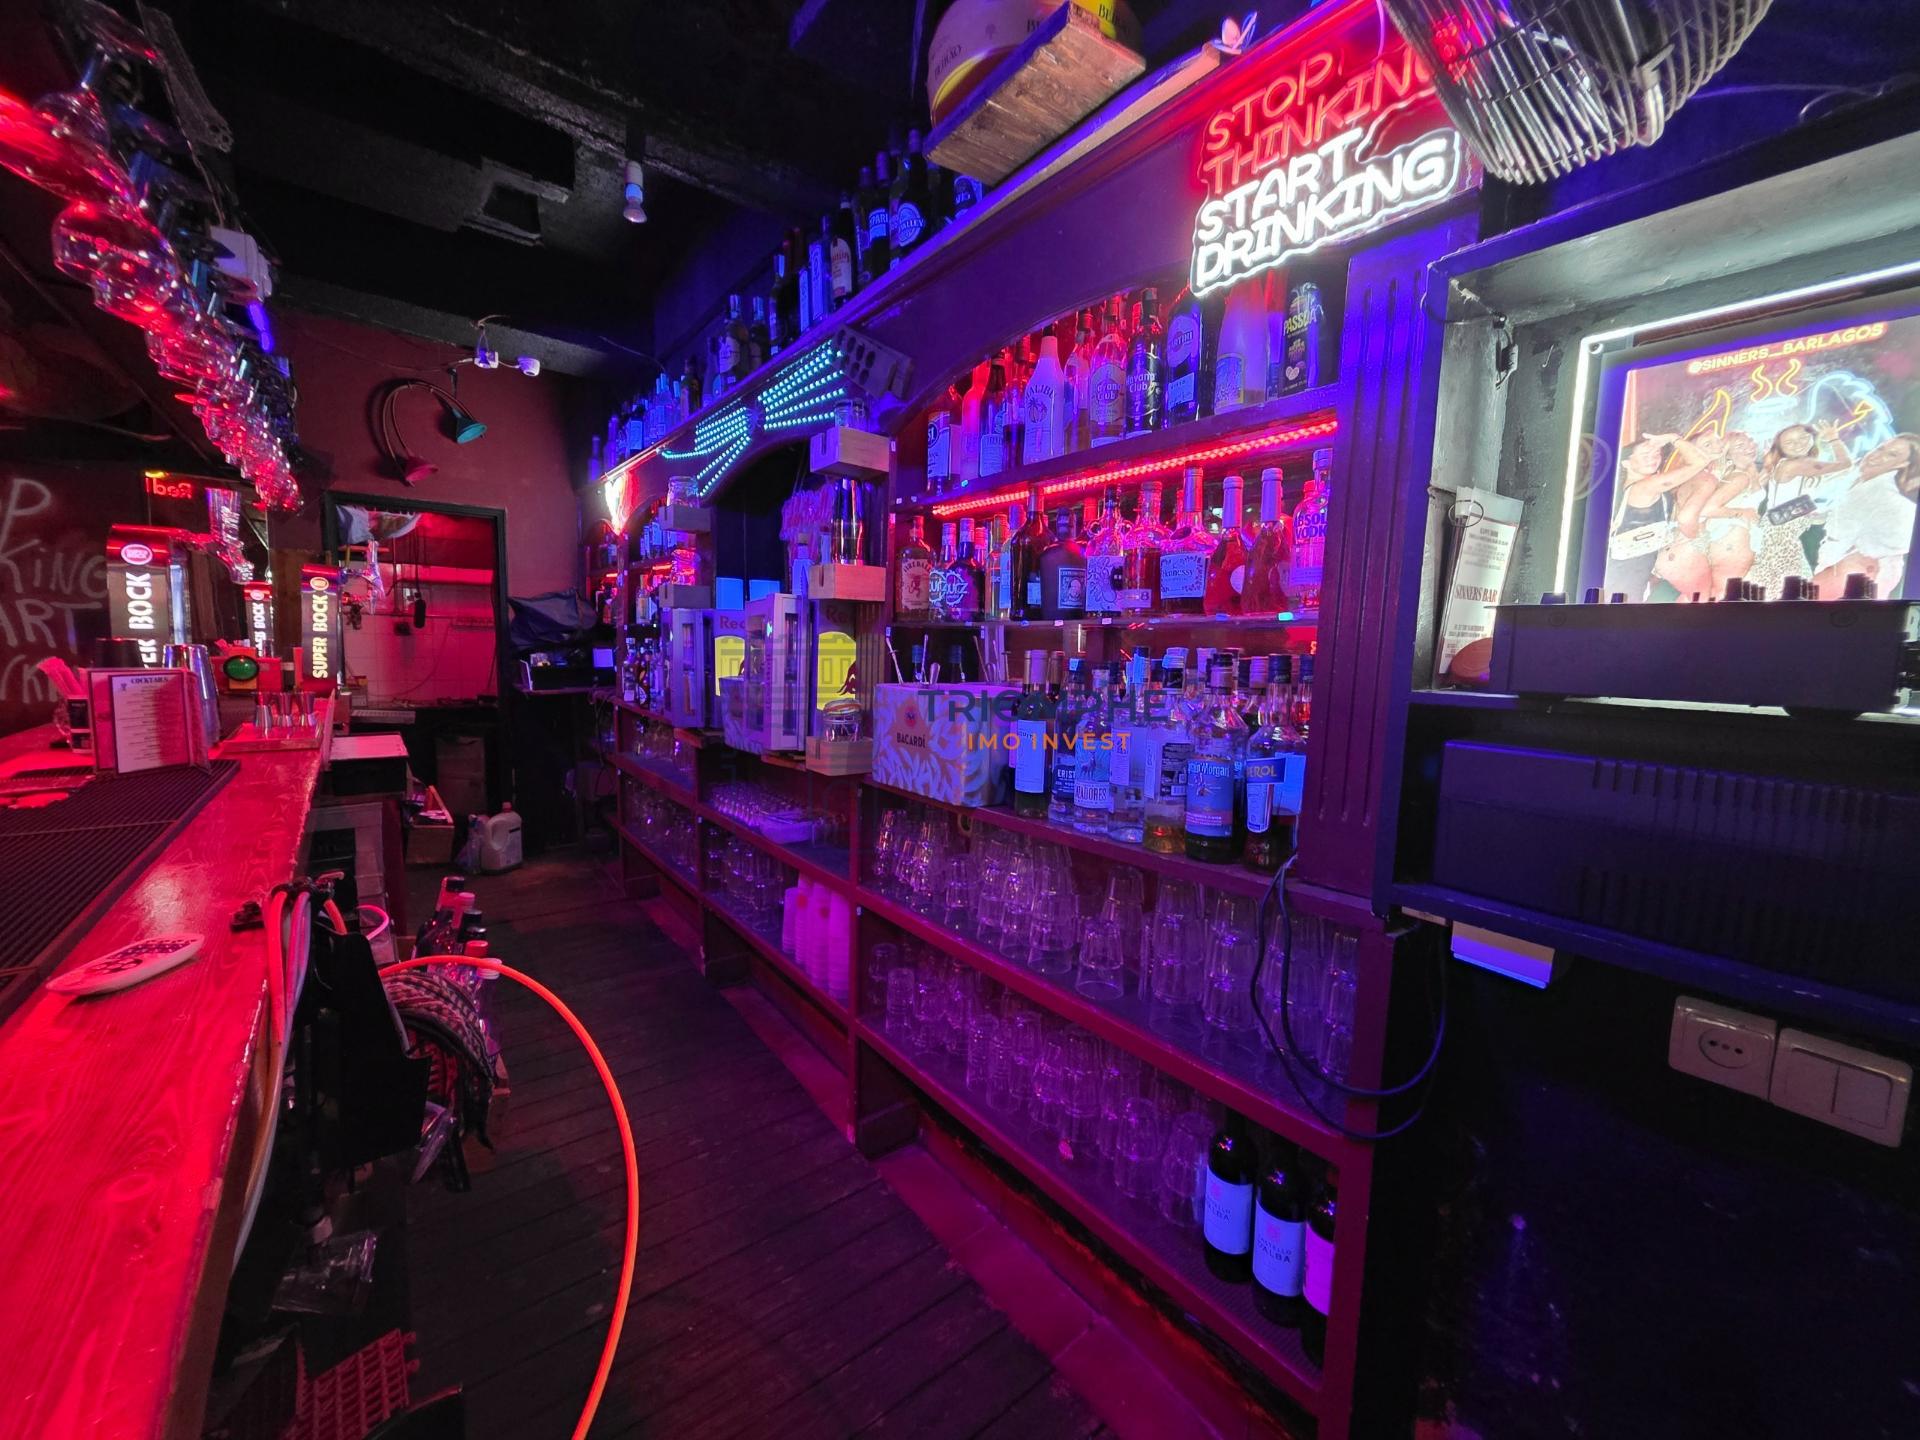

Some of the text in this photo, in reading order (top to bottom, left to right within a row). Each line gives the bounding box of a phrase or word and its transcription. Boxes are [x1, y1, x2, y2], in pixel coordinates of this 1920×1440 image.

[1206, 52, 1334, 151] STOP
[1196, 138, 1448, 287] DRINKING
[1197, 127, 1364, 241] START
[1295, 525, 1327, 539] VODK
[125, 571, 155, 630] BOCK
[1482, 587, 1498, 604] BAR
[312, 594, 329, 679] SUPER BOCK
[1057, 768, 1076, 779] ERIST
